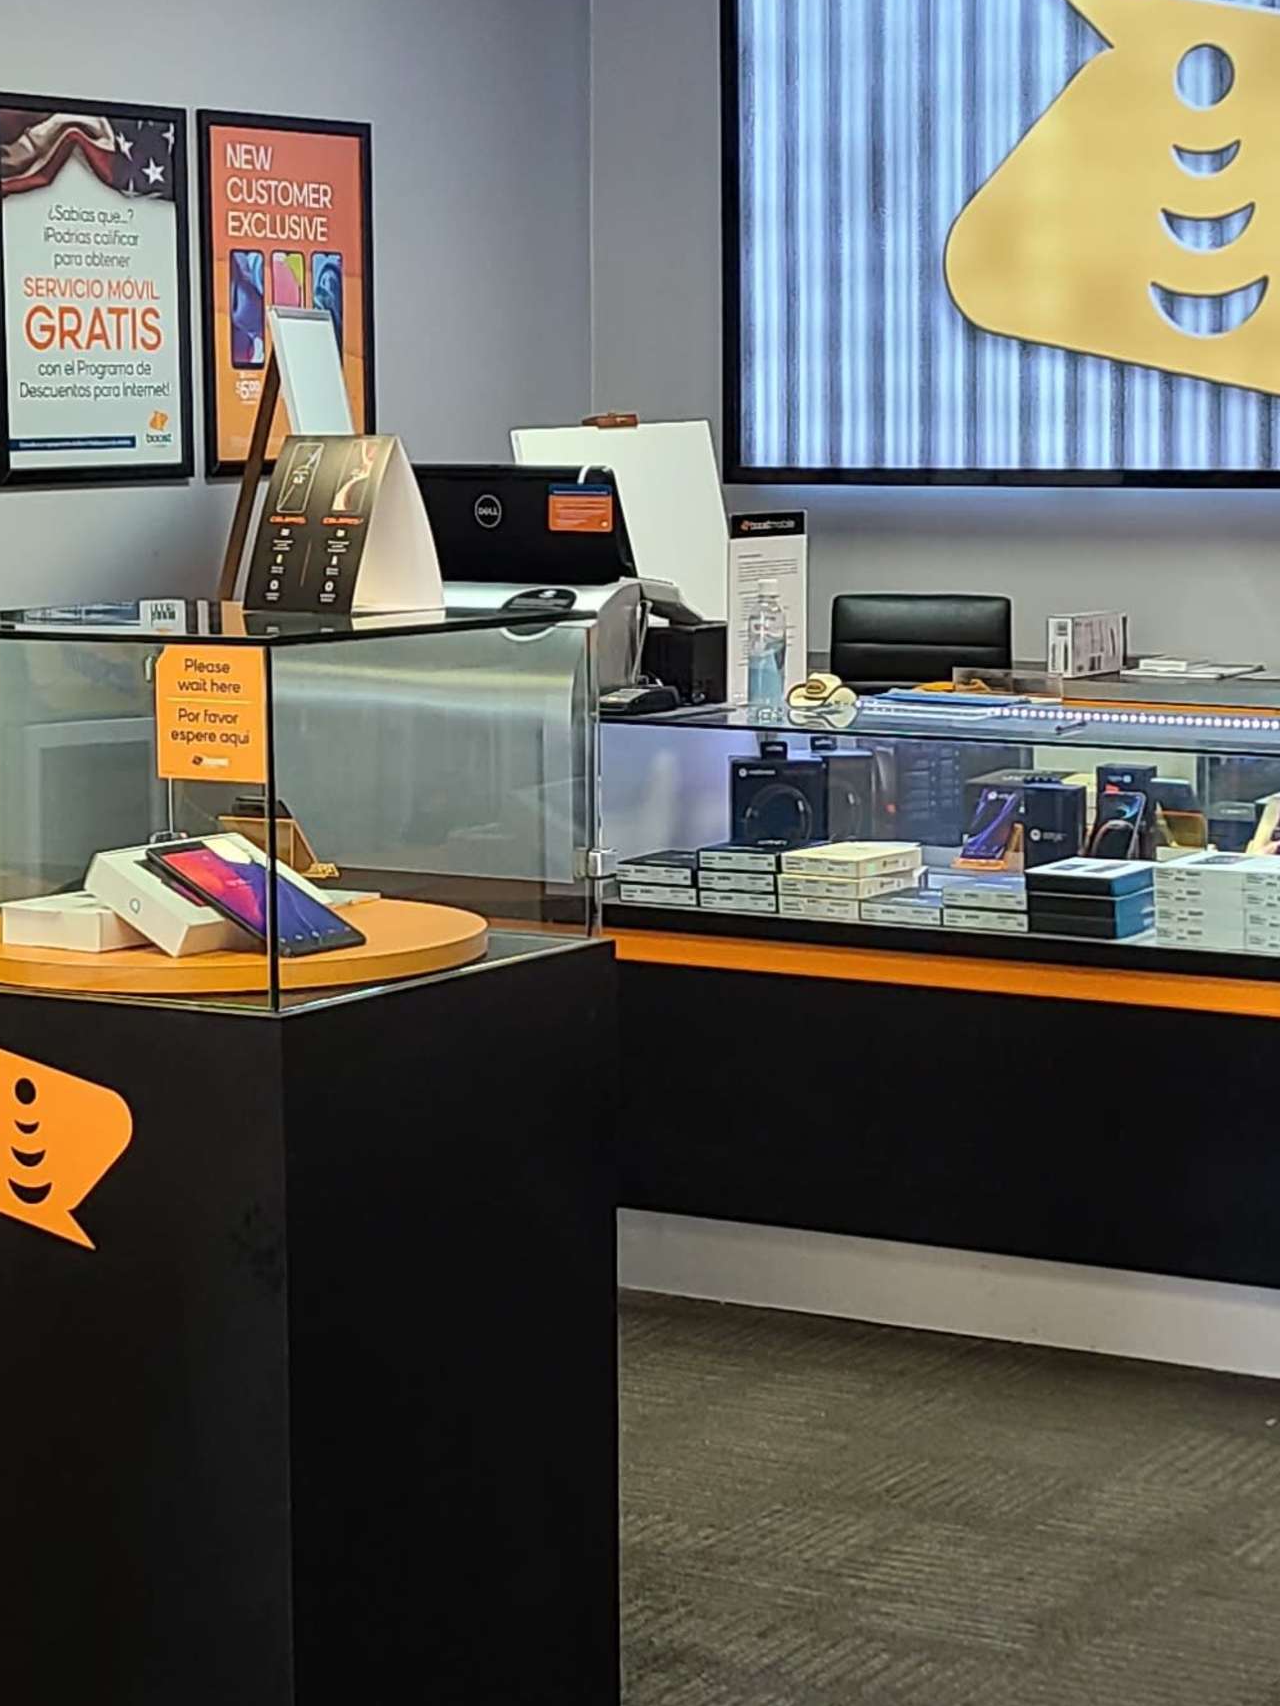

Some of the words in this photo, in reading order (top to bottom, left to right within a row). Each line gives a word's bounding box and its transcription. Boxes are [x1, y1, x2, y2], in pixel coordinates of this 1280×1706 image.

[226, 143, 272, 171] NEW
[226, 177, 332, 209] CUSTOMER
[227, 211, 329, 241] EXCLUSIVE
[54, 253, 82, 269] para
[85, 251, 131, 268] obtener
[23, 277, 104, 298] SERVICIO
[107, 275, 160, 300] MÓVIL
[25, 305, 162, 351] GRATIS
[38, 363, 61, 376] con
[64, 361, 75, 376] el
[77, 359, 134, 380] Programa
[136, 361, 152, 376] de
[20, 382, 91, 398] Descuentos
[94, 385, 120, 401] para
[184, 658, 230, 673] Please
[178, 679, 208, 692] wait
[210, 678, 241, 693] here
[178, 708, 200, 723] Por
[204, 709, 238, 724] favor
[171, 730, 216, 745] espere
